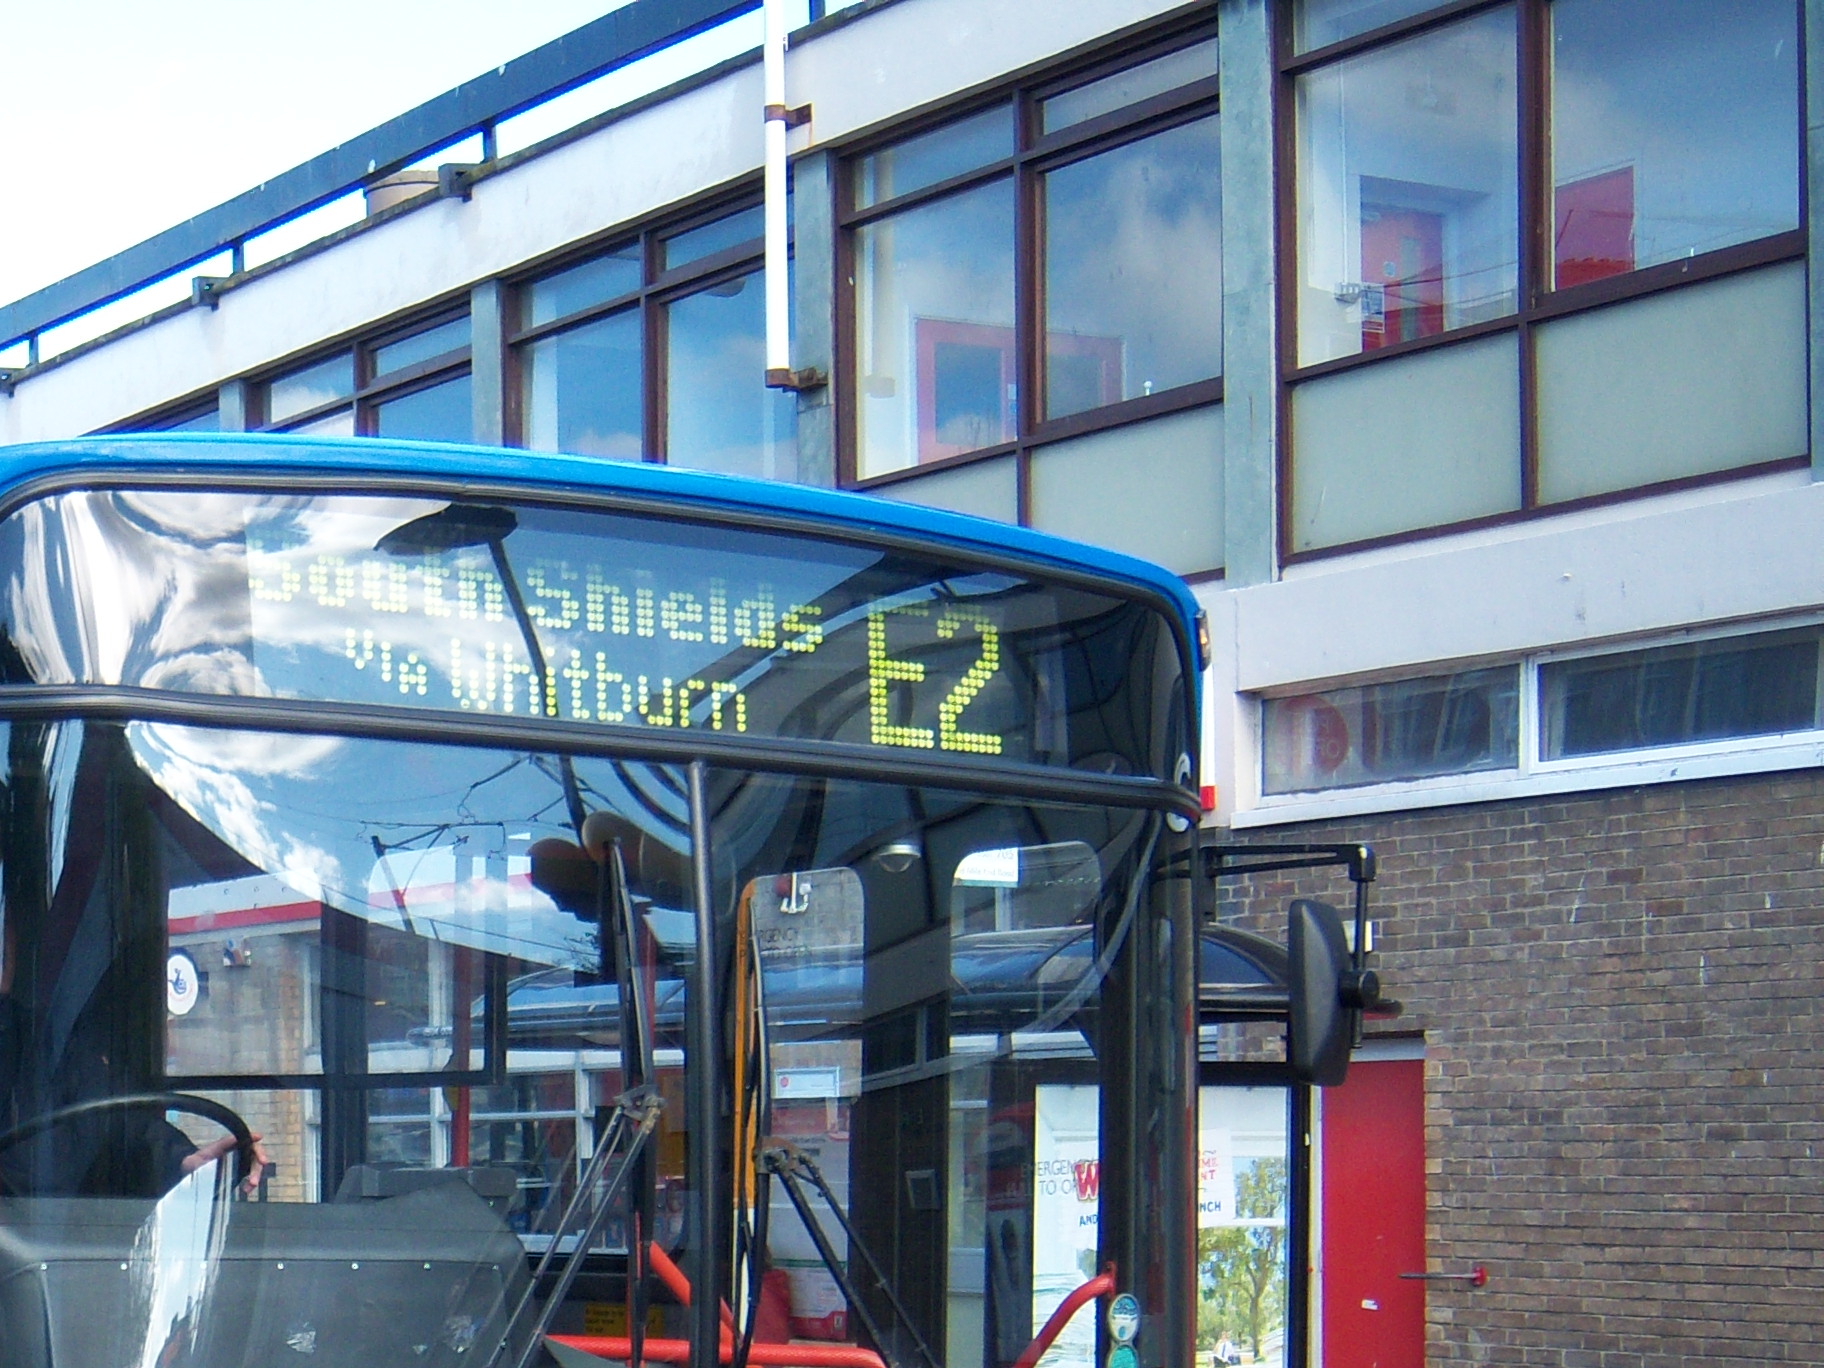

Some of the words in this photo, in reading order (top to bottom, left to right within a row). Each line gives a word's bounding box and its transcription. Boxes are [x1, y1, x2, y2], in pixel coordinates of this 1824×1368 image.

[249, 537, 504, 622] South
[526, 556, 824, 653] Shields
[450, 637, 747, 732] Whitburn
[867, 602, 1002, 754] E2
